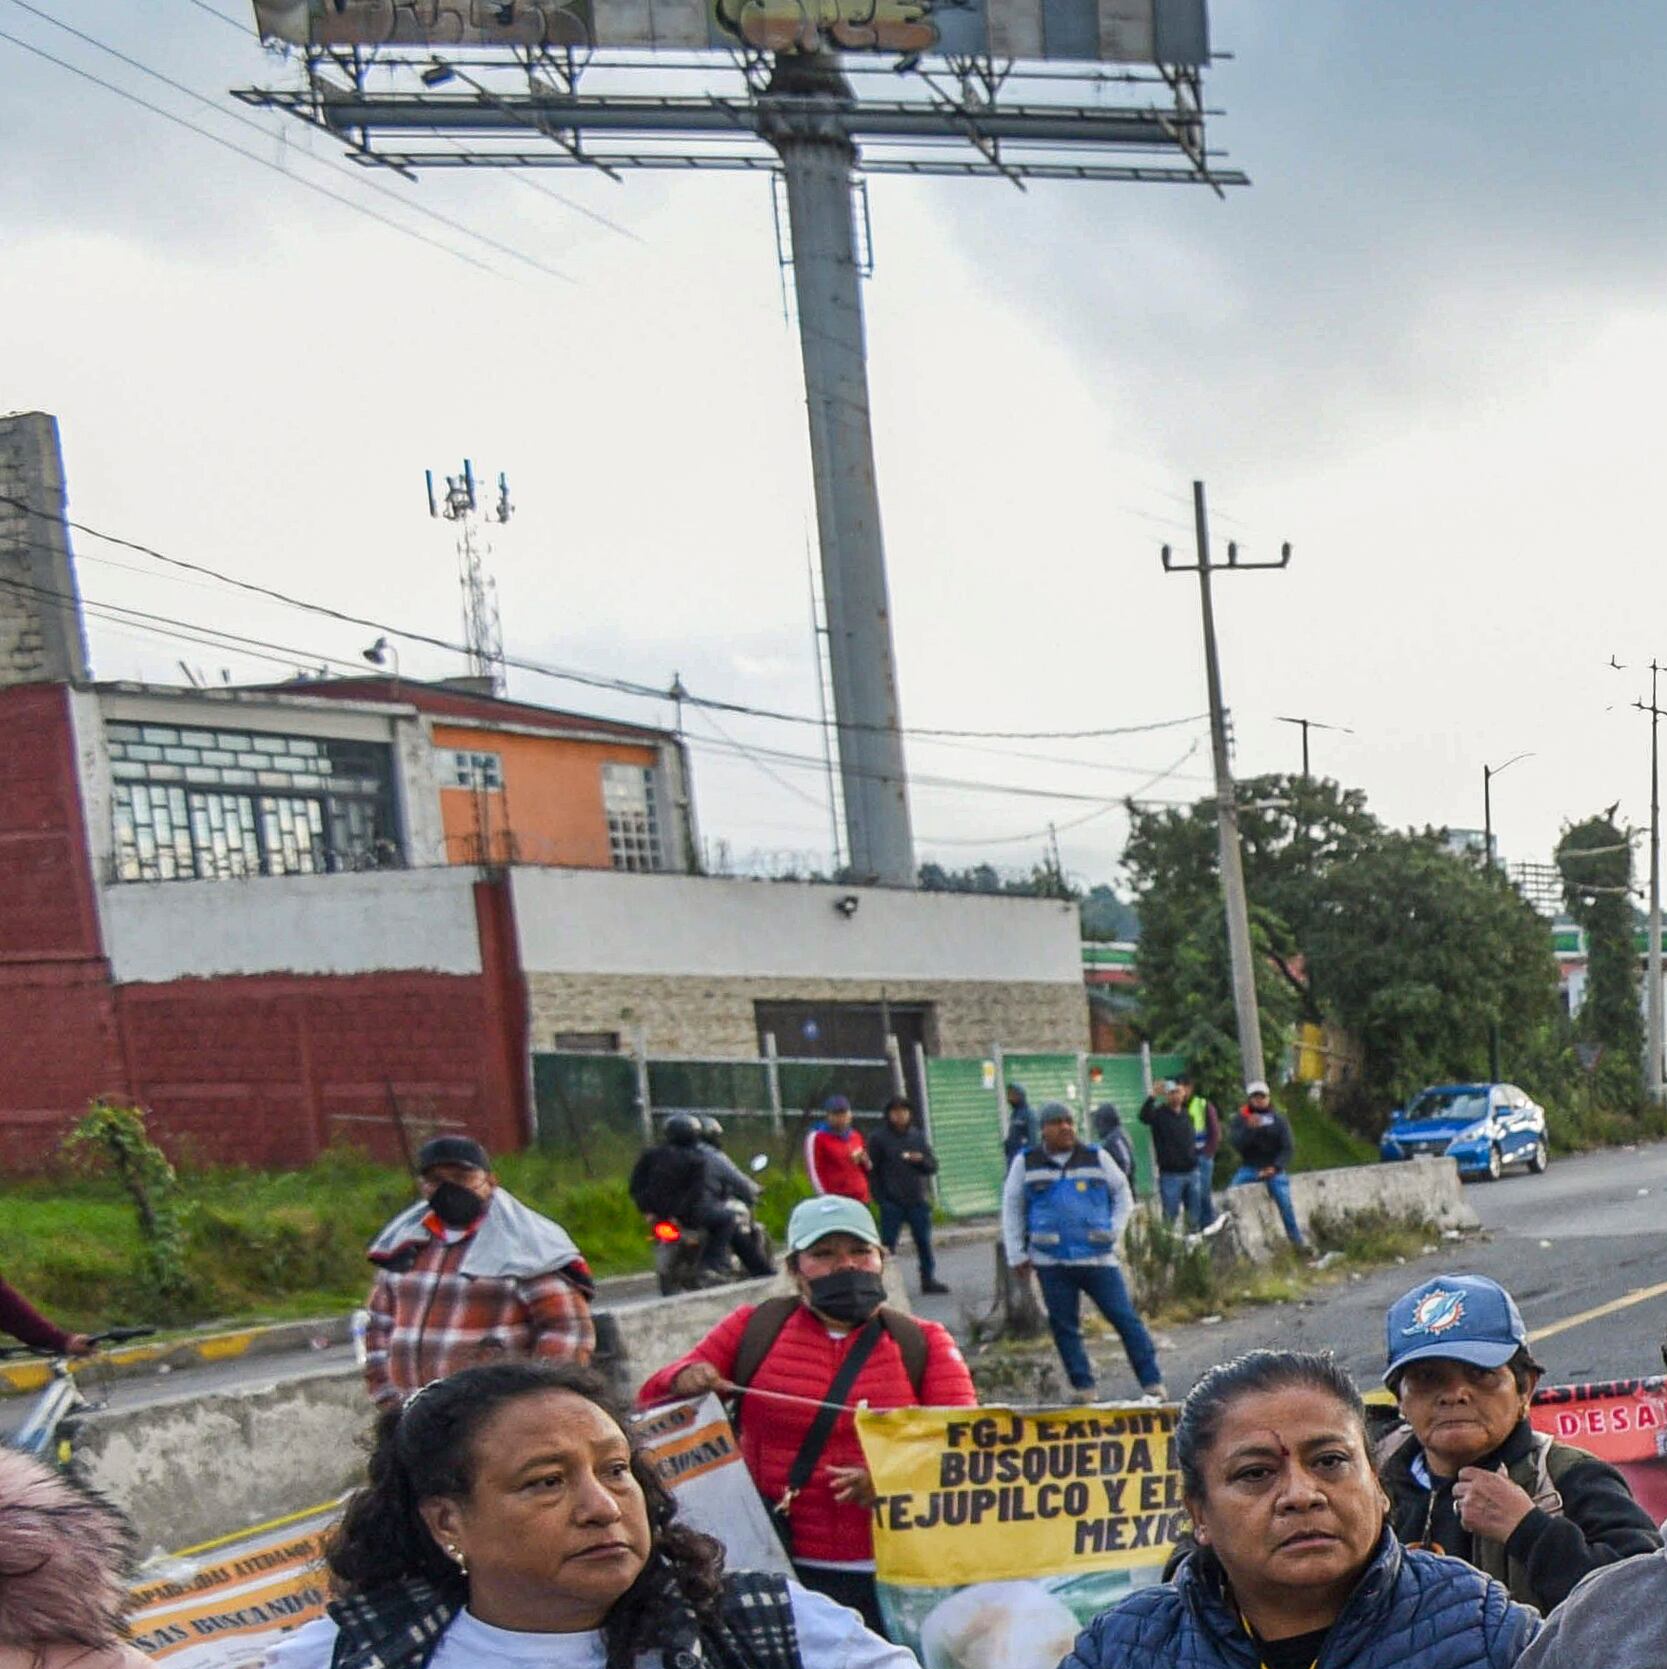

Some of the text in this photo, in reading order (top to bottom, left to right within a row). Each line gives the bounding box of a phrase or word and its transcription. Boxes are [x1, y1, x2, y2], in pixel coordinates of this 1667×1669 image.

[946, 1416, 1024, 1448] FGJ
[940, 1439, 1154, 1488] BUSQUEDA
[872, 1482, 1088, 1531] TEJUPILCO
[1102, 1478, 1128, 1514] Y
[191, 1586, 323, 1635] BUSCANDO
